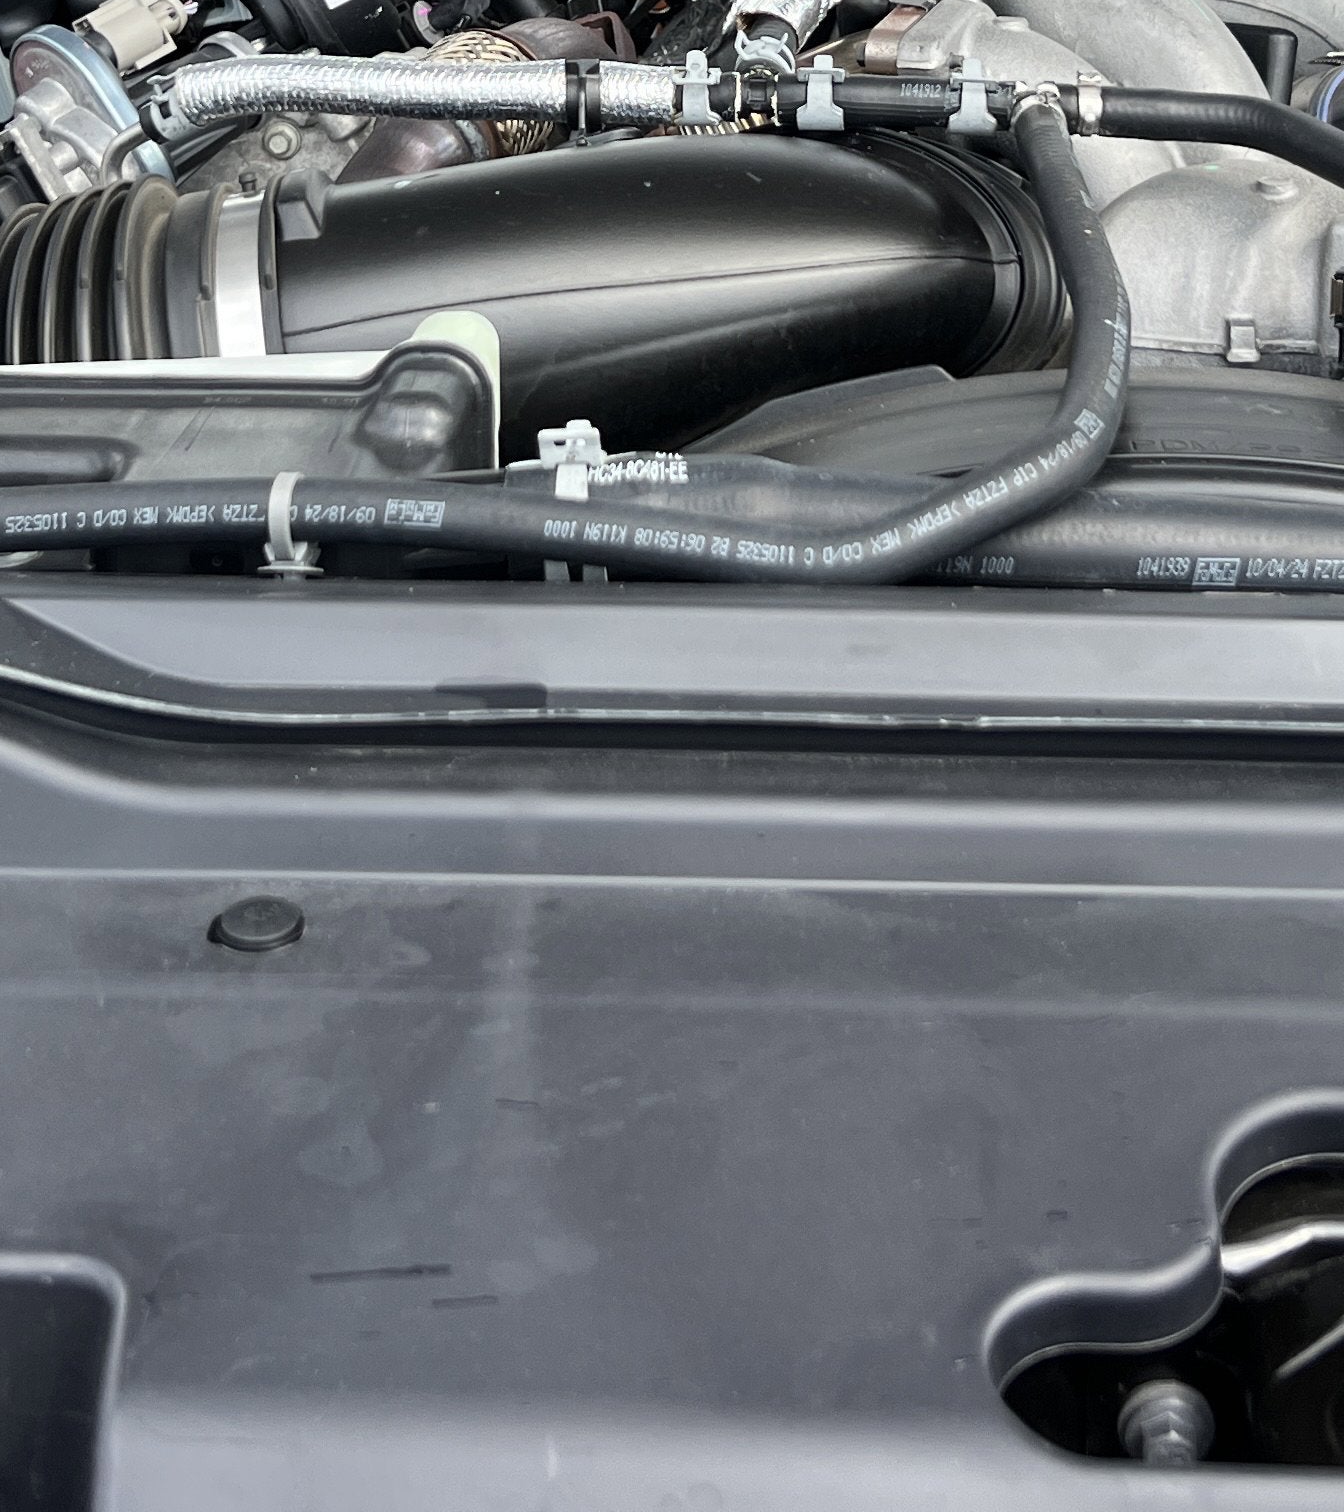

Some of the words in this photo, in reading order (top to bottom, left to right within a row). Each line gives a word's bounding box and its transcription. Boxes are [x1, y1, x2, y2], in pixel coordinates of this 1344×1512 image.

[1013, 462, 1038, 487] CIP
[5, 514, 68, 534] 1105325
[77, 511, 87, 527] C
[93, 509, 127, 527] CO/D
[134, 507, 160, 525] MEX
[304, 506, 376, 524] 09/18/24
[385, 499, 444, 530] FoMoCo
[544, 519, 576, 539] 1000
[584, 525, 627, 545] K119N
[634, 527, 706, 552] 06:59:08
[710, 535, 729, 557] B2
[870, 528, 901, 555] MEX
[736, 539, 795, 565] 1105325
[804, 546, 814, 565] C
[822, 542, 863, 564] CO/D
[979, 555, 1015, 575] 1000
[1136, 556, 1191, 578] 1041939
[1245, 557, 1310, 580] 10/04/24
